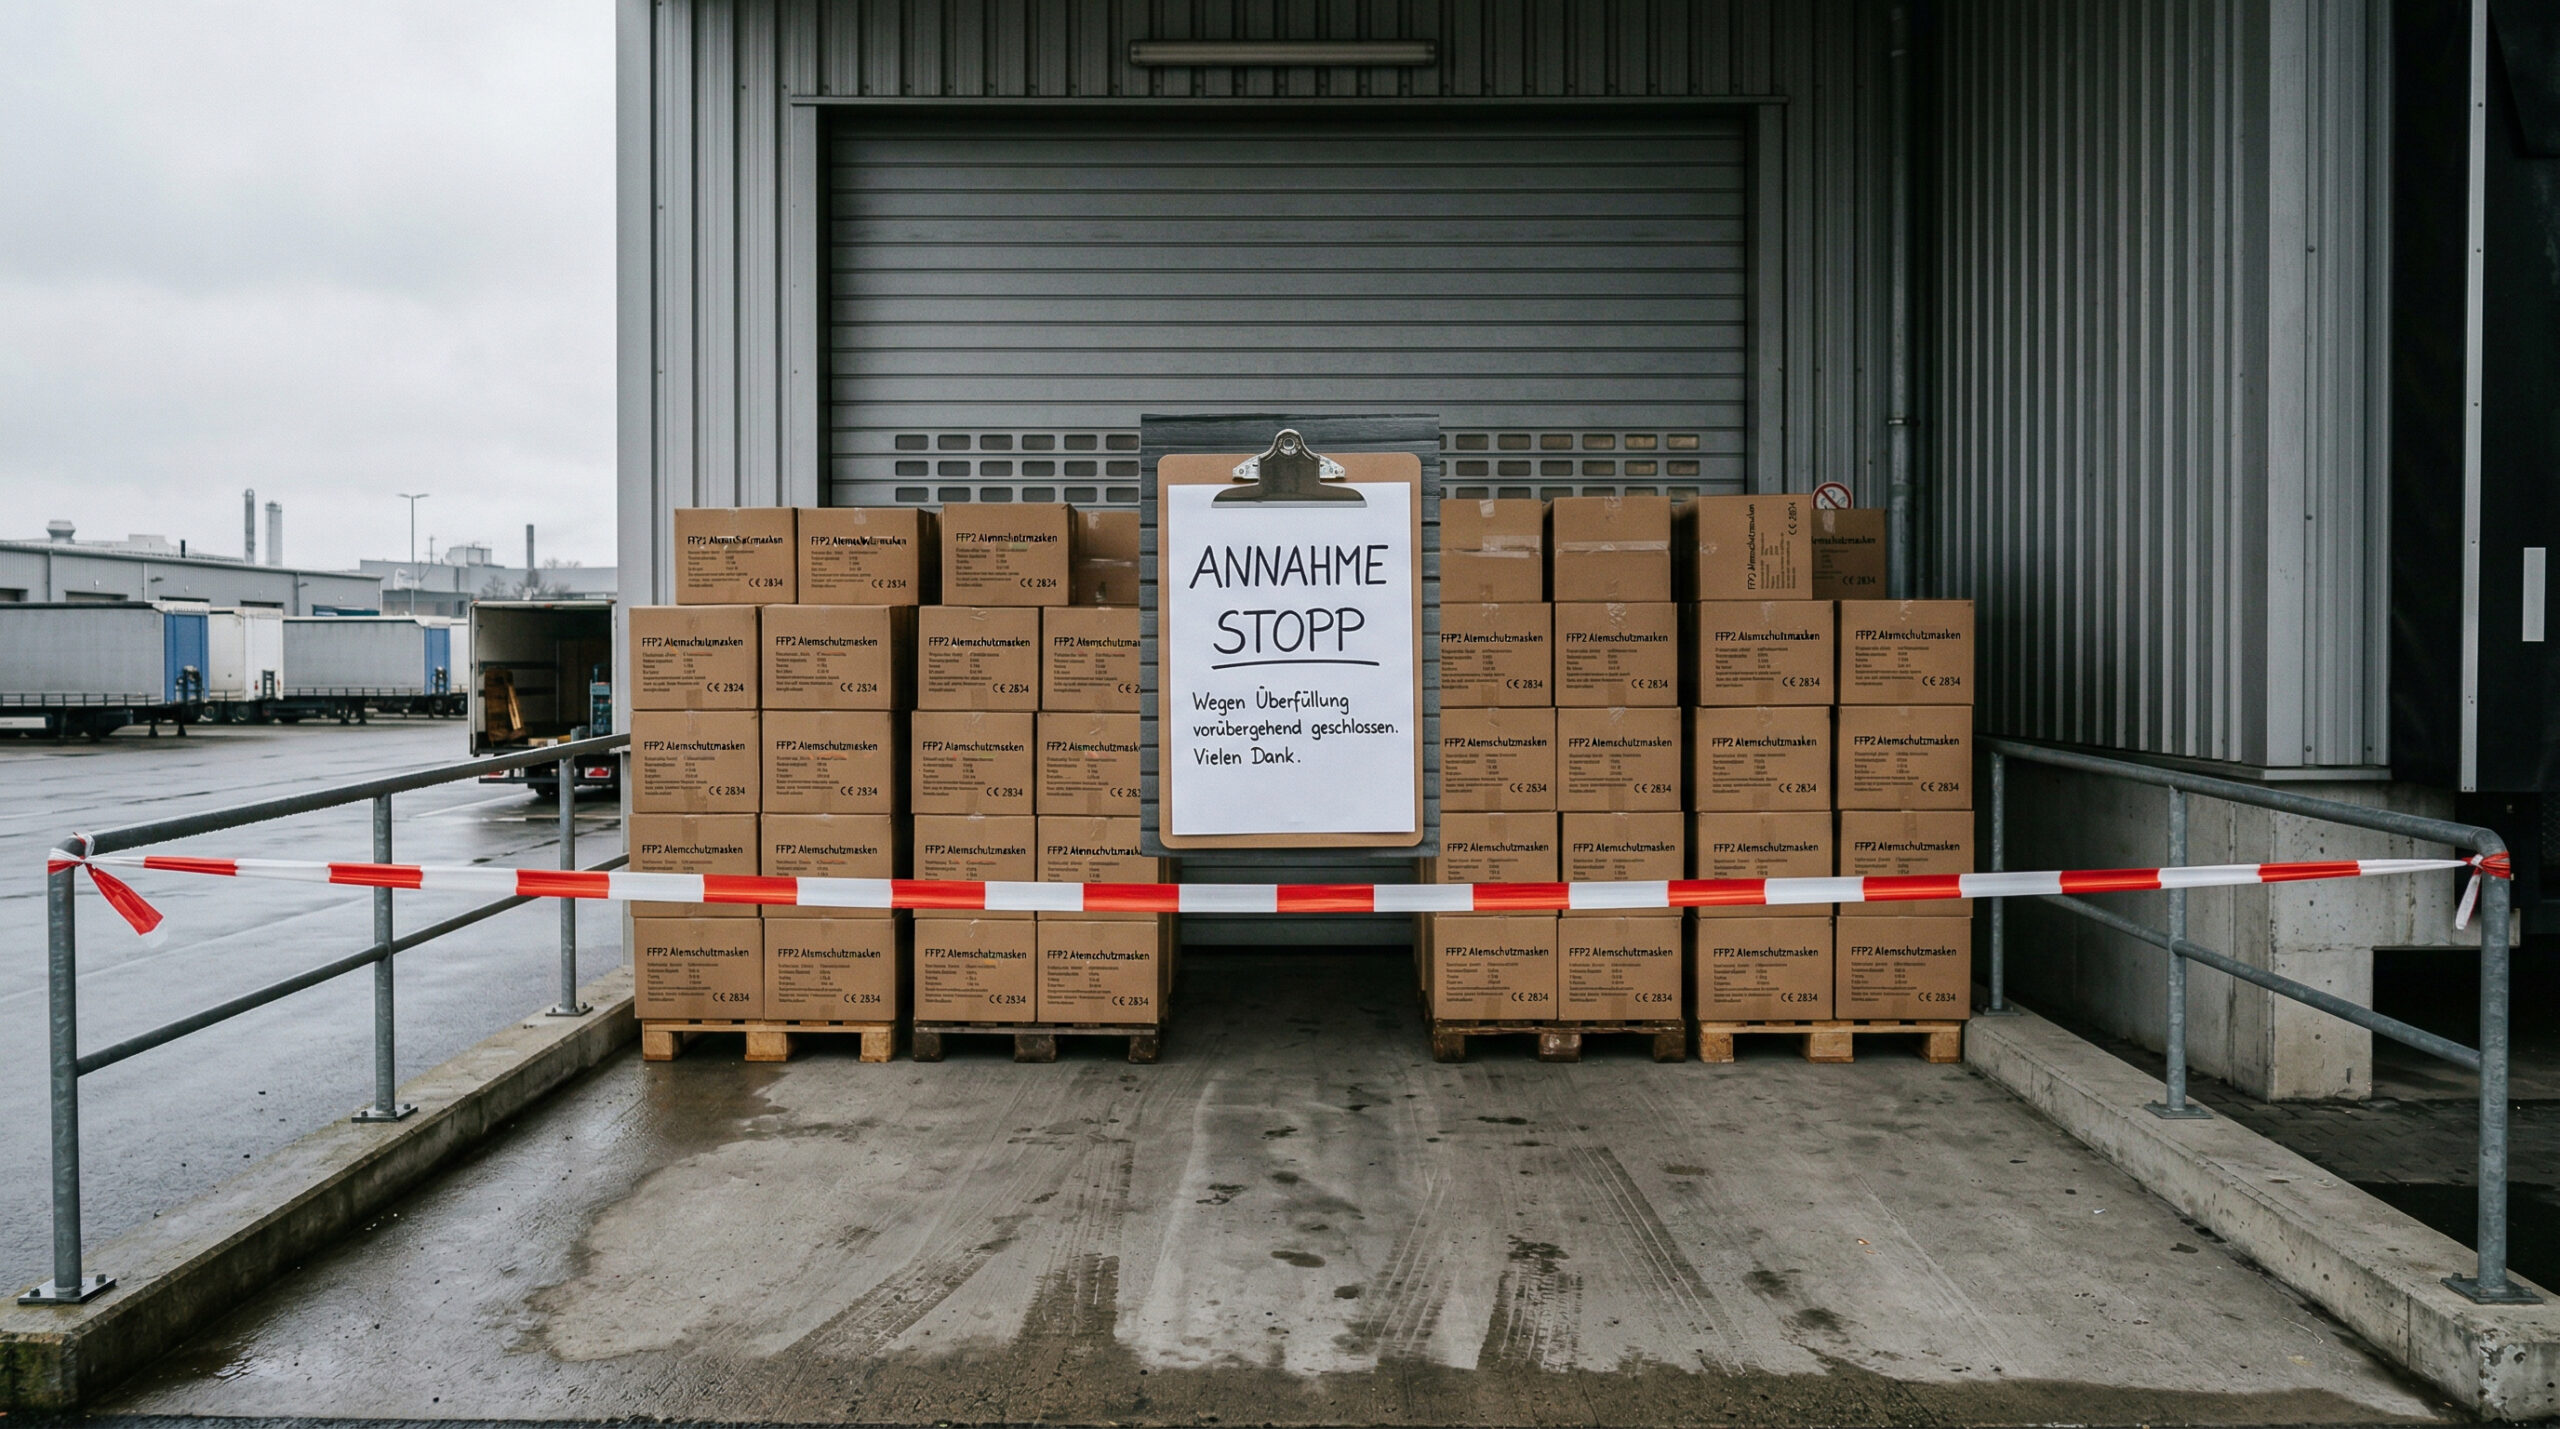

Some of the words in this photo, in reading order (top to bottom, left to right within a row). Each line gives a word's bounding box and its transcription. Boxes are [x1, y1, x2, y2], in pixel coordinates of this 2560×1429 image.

[956, 533, 976, 542] FFP2
[1189, 545, 1388, 589] ANNAHME
[764, 578, 783, 587] 2834
[1213, 607, 1365, 654] STOPP
[1856, 630, 1877, 640] FFP2
[776, 636, 796, 646] FFP2
[1441, 634, 1461, 643] FFP2
[1566, 633, 1587, 642] FFP2
[1715, 632, 1736, 641] FFP2
[929, 637, 949, 646] FFP2
[1054, 637, 1074, 647] FFP2
[1523, 680, 1543, 688] 2834
[1648, 680, 1668, 688] 2834
[1799, 677, 1820, 687] 2834
[1939, 677, 1960, 686] 2834
[1193, 692, 1246, 716] Wegen
[1256, 686, 1350, 715] Überfüllung
[1193, 719, 1302, 742] vorübergehend
[1311, 718, 1399, 740] geschlossen.
[1445, 738, 1465, 747] FFP2
[1569, 738, 1590, 747] FFP2
[1712, 738, 1733, 747] FFP2
[1854, 736, 1876, 745] FFP2
[644, 741, 664, 750] FFP2
[923, 741, 943, 751] FFP2
[1047, 741, 1067, 751] FFP2
[1193, 747, 1242, 766] Vielen
[1251, 747, 1301, 765] Dank.
[725, 786, 745, 795] 2834
[1651, 784, 1671, 793] 2834
[1795, 784, 1816, 792] 2834
[1938, 783, 1959, 792] 2834
[1002, 788, 1023, 797] 2834
[776, 845, 796, 854] FFP2
[1048, 846, 1068, 855] FFP2
[1447, 843, 1468, 852] FFP2
[1573, 843, 1593, 852] FFP2
[1714, 844, 1735, 852] FFP2
[1855, 842, 1876, 851] FFP2
[647, 947, 667, 956] FFP2
[778, 949, 799, 957] FFP2
[925, 949, 945, 958] FFP2
[1048, 950, 1067, 959] FFP2
[1446, 947, 1467, 956] FFP2
[1569, 948, 1590, 956] FFP2
[1714, 948, 1734, 957] FFP2
[1852, 946, 1873, 956] FFP2
[729, 993, 749, 1002] 2834
[860, 994, 880, 1003] 2834
[1006, 995, 1026, 1004] 2834
[1528, 993, 1548, 1001] 2834
[1652, 993, 1672, 1002] 2834
[1797, 993, 1818, 1002] 2834
[1935, 993, 1956, 1002] 2834
